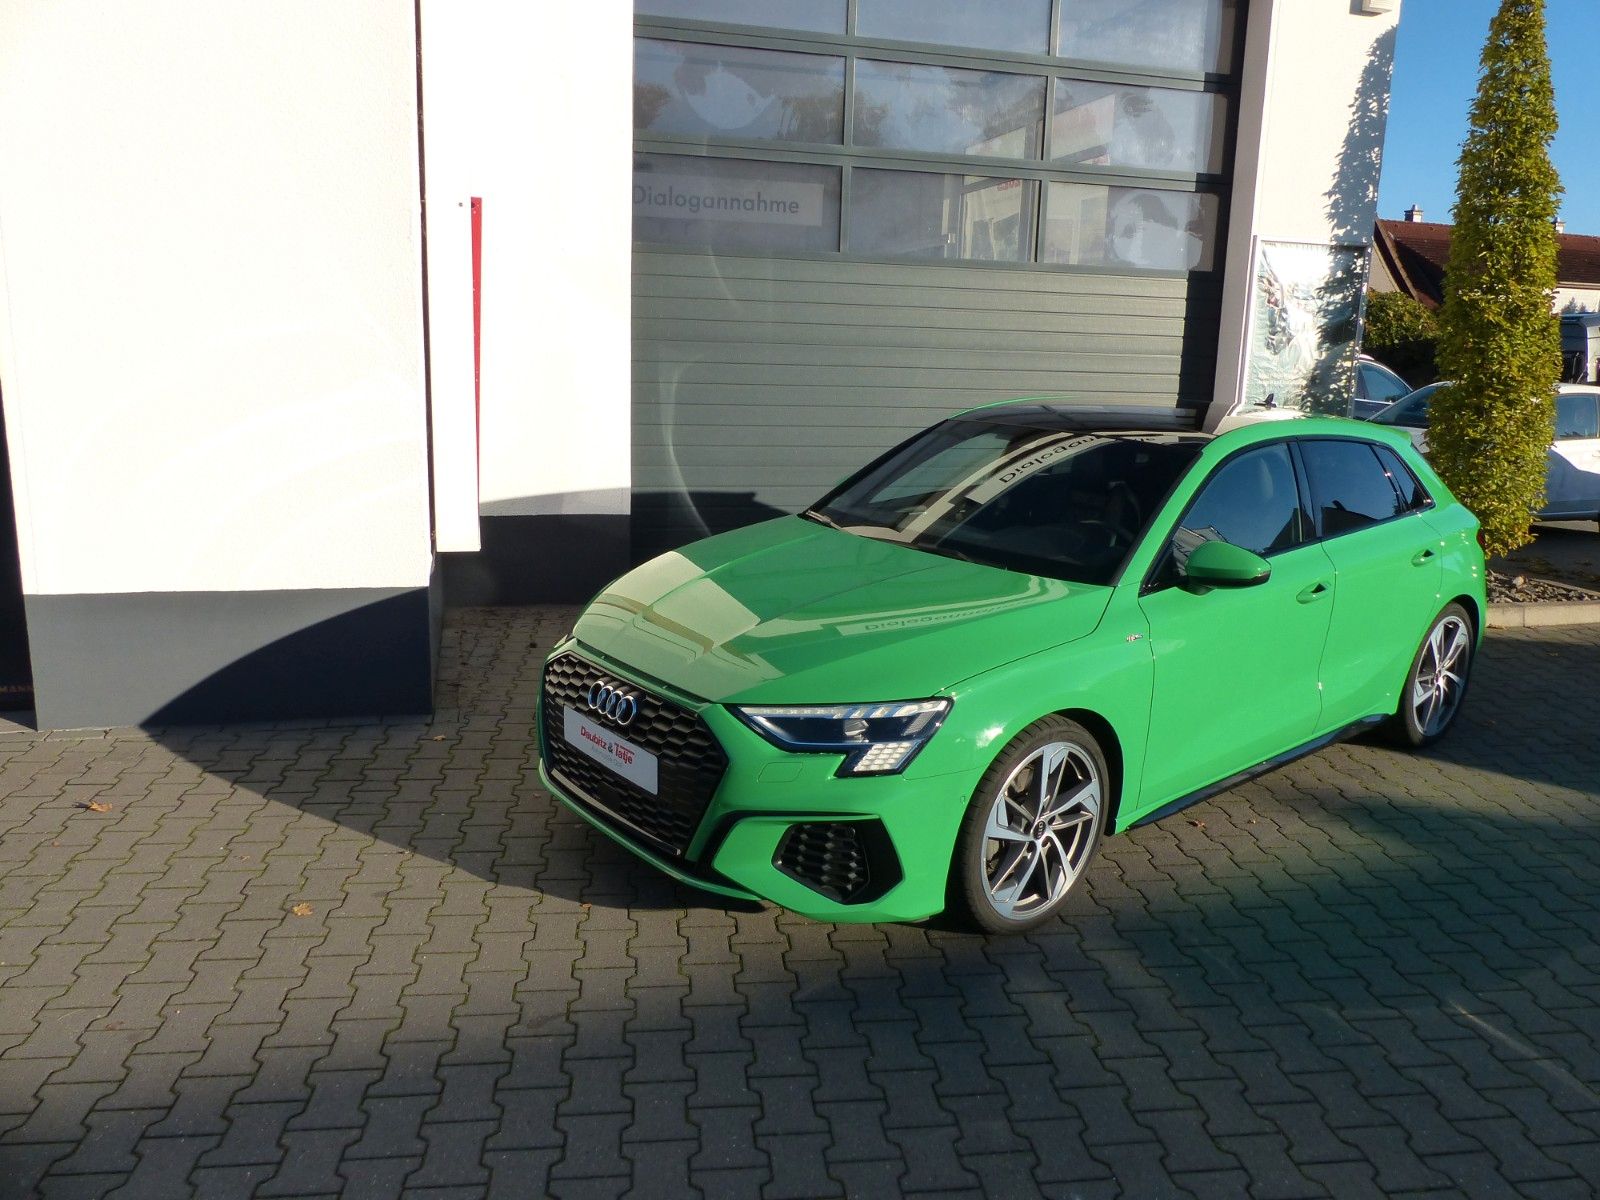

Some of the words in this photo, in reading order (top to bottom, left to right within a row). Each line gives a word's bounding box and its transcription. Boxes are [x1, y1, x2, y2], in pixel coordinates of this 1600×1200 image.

[633, 185, 799, 214] Dialogannahme
[581, 726, 607, 749] Daubitz
[608, 742, 613, 754] &
[614, 742, 635, 764] Tatje
